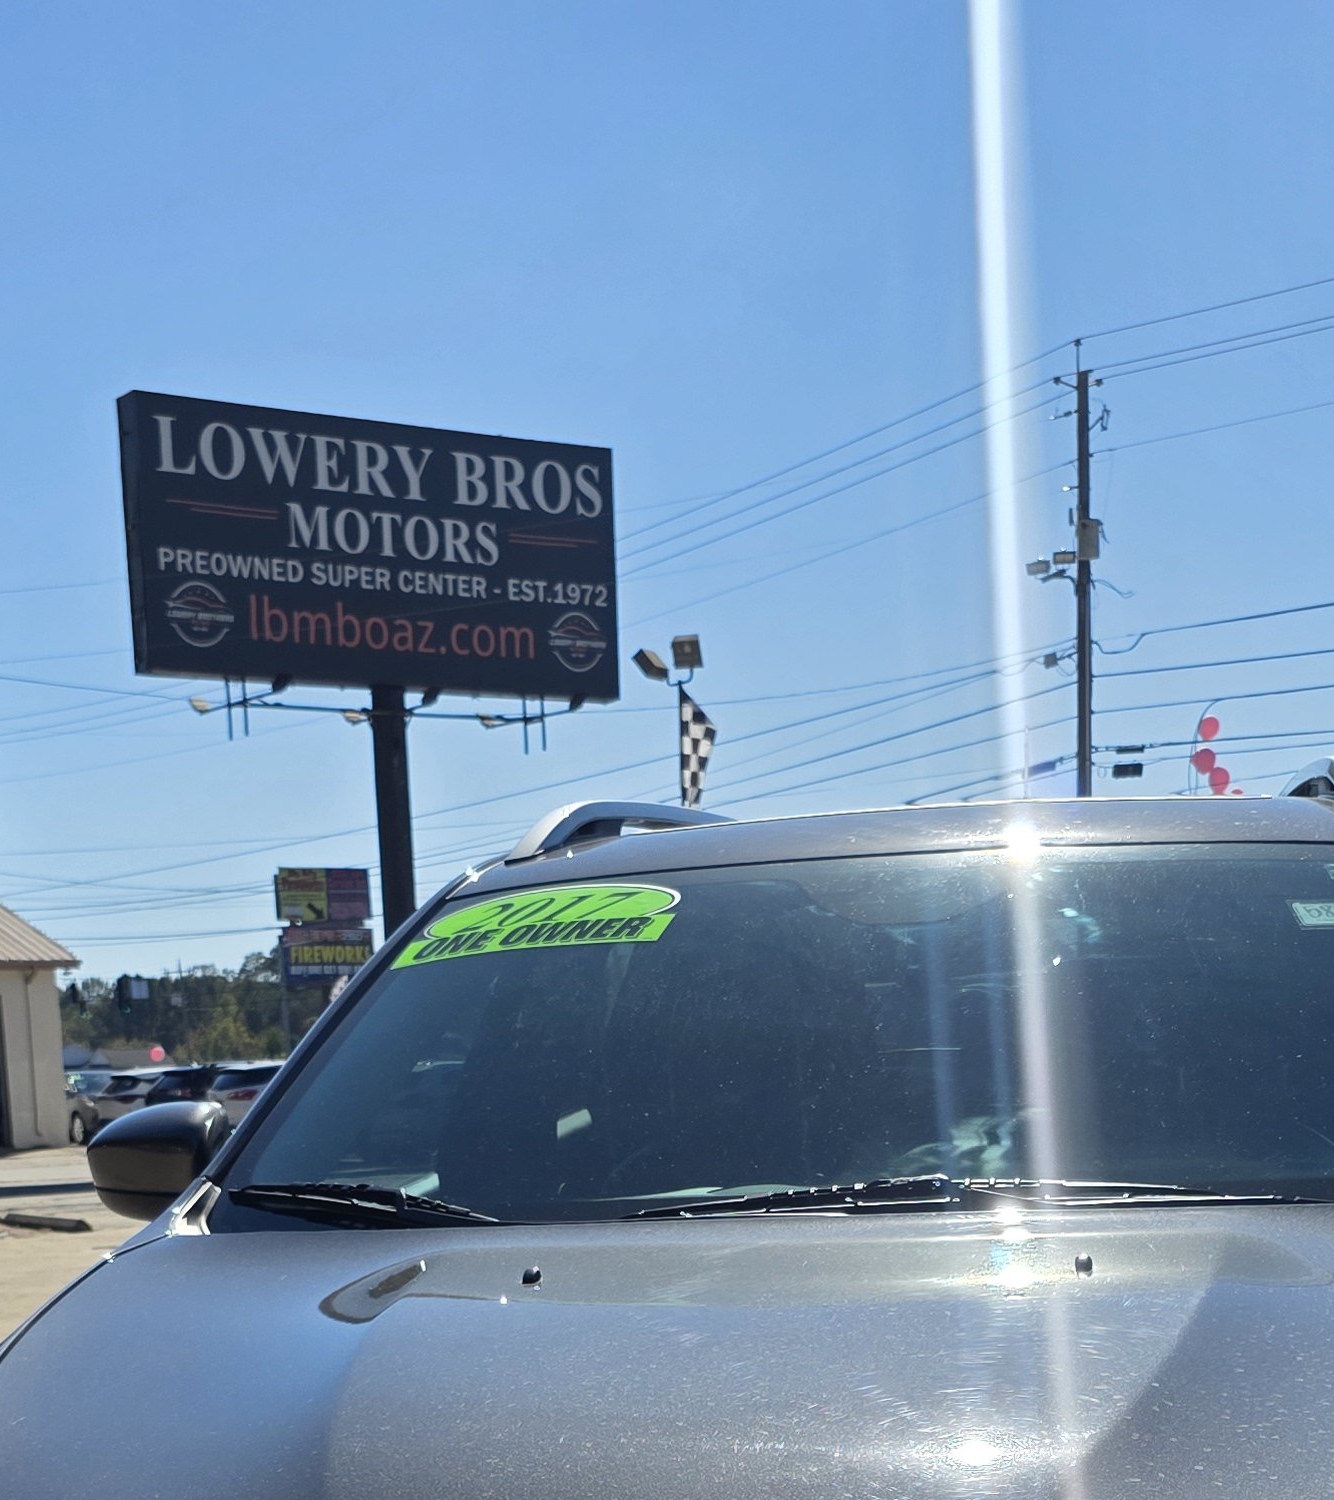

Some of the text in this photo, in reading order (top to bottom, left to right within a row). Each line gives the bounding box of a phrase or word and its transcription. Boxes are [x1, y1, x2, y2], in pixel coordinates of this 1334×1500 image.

[152, 415, 603, 519] LOWERY BROS
[285, 502, 499, 567] MOTORS
[156, 546, 304, 583] PREOWNED
[310, 561, 391, 591] SUPER
[397, 570, 487, 599] CENTER
[249, 593, 535, 660] lbmboaz.com
[411, 926, 505, 962] ONE
[497, 916, 655, 948] OWNER
[457, 891, 646, 933] 2017
